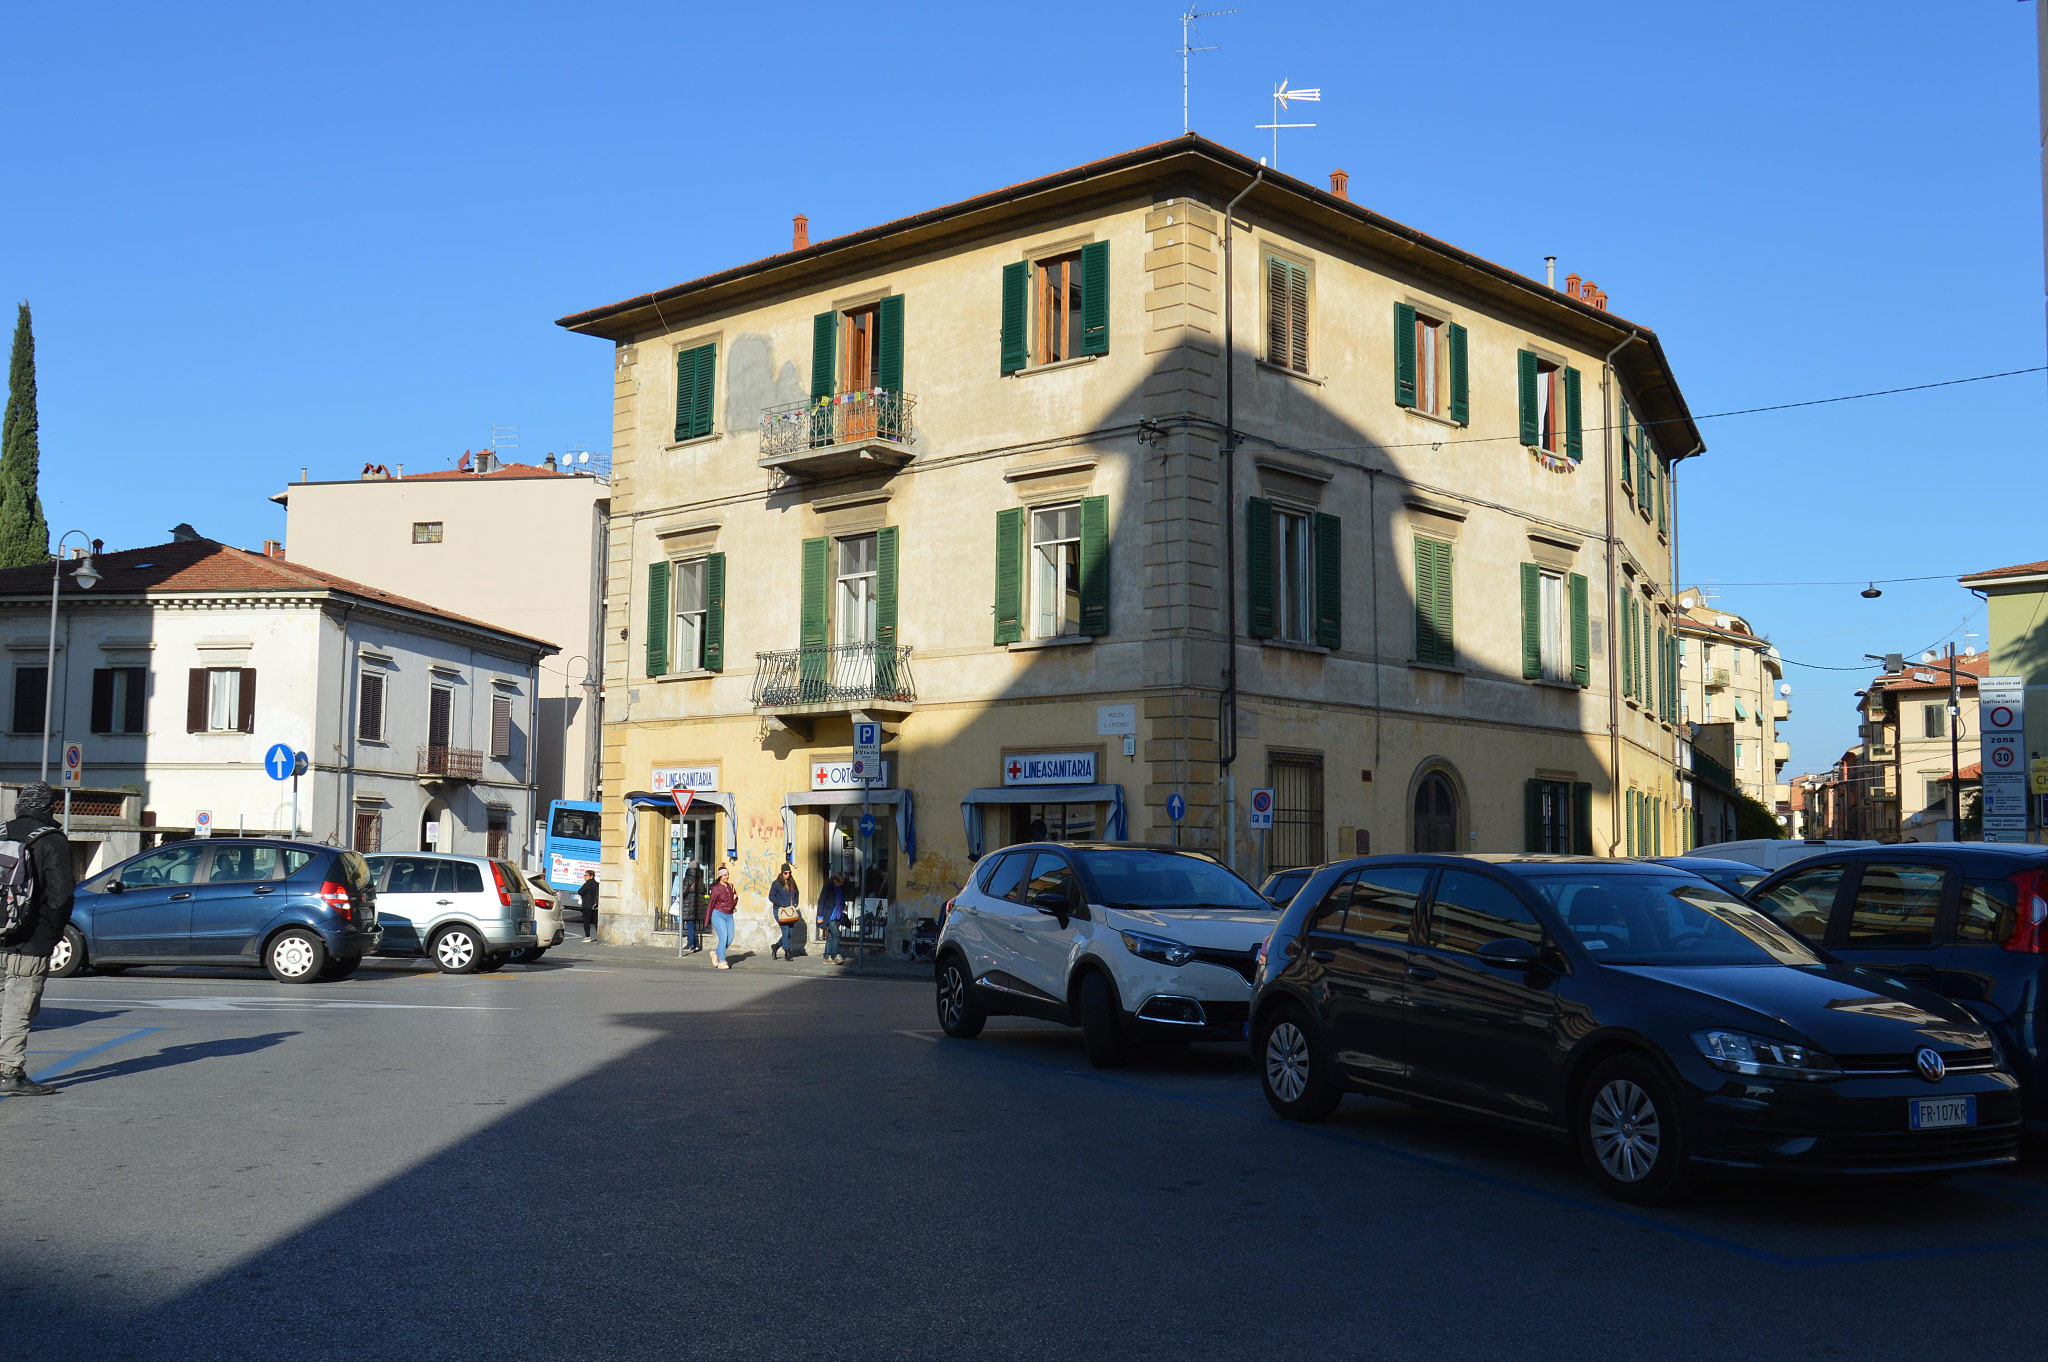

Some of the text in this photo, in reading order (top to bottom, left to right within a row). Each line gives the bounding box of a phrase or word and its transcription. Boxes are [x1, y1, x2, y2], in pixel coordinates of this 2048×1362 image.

[862, 727, 871, 742] P
[1996, 753, 2010, 762] 30
[1023, 759, 1092, 778] LINEASANITARIA
